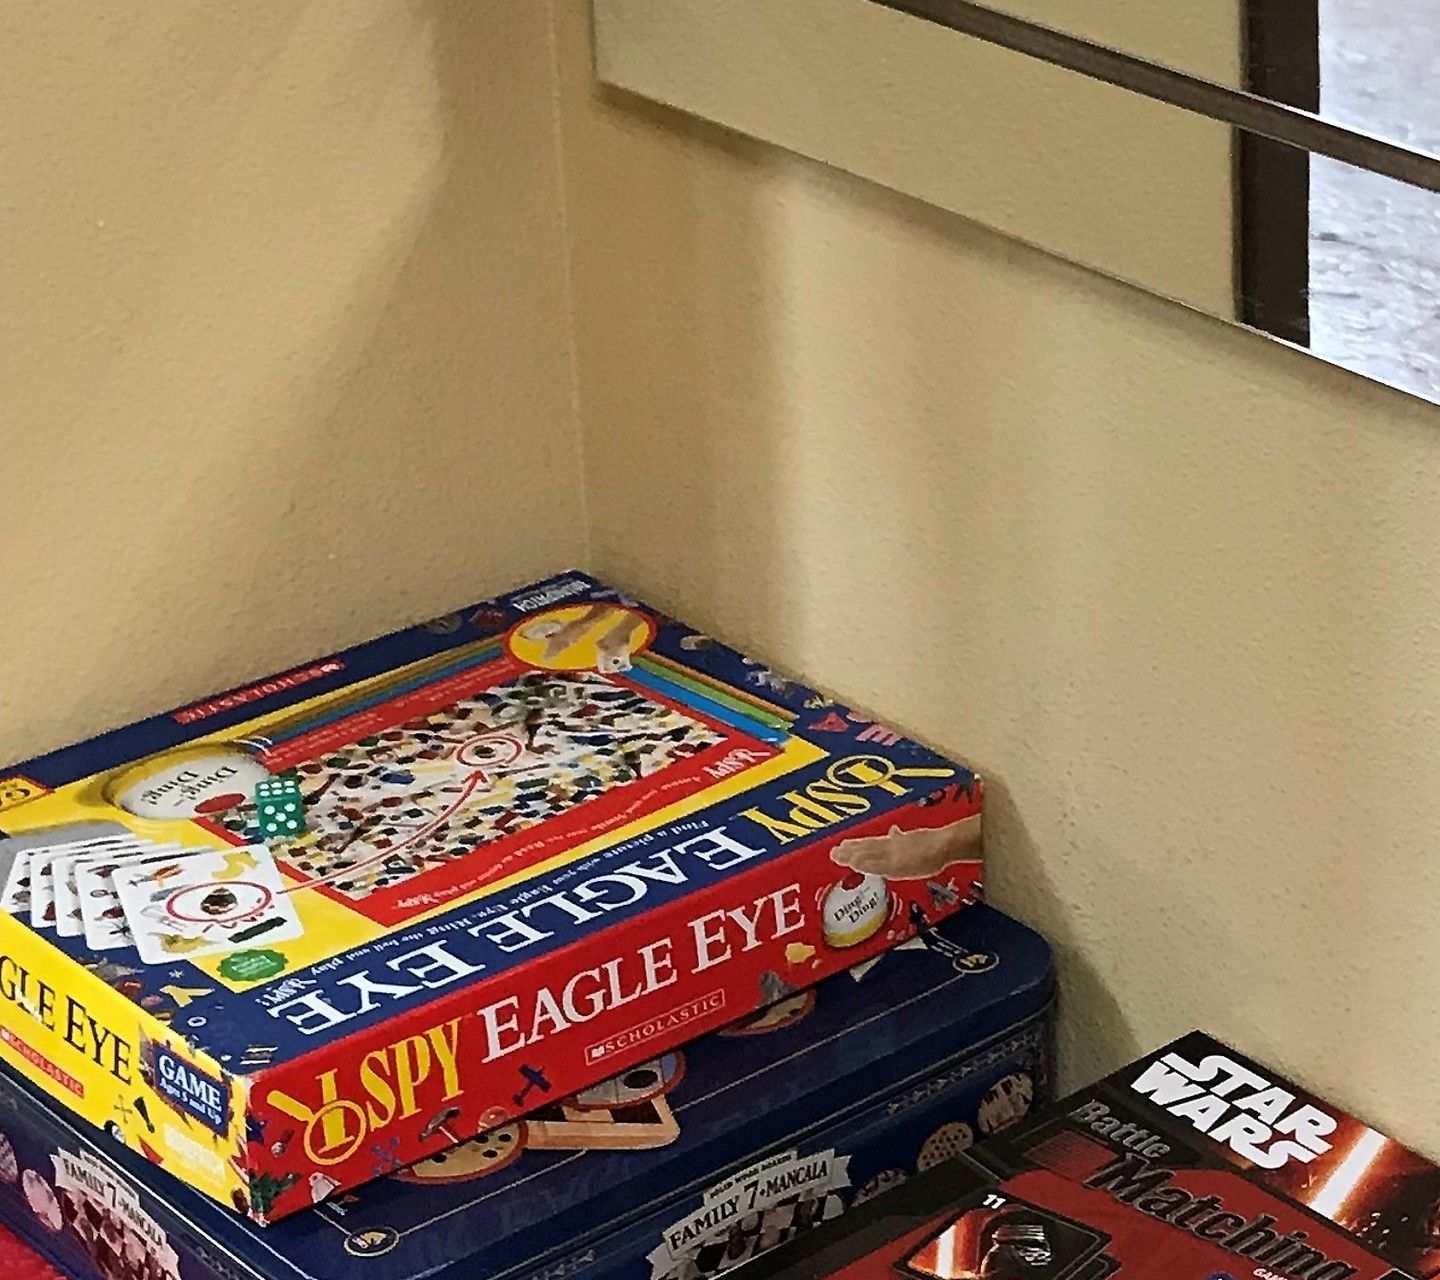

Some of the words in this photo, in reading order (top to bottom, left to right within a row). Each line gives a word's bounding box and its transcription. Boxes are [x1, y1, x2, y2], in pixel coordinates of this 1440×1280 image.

[737, 782, 872, 845] SPY
[468, 824, 767, 953] EAGLE
[509, 885, 553, 907] Eagle
[266, 939, 486, 1035] EYE
[311, 955, 345, 976] play
[360, 1019, 464, 1130] SPY
[477, 937, 677, 1060] EAGLE
[686, 883, 806, 976] EYE
[604, 995, 722, 1055] SCHOLASTIC
[63, 994, 132, 1086] EYE
[158, 1055, 222, 1110] GAME
[1160, 1052, 1339, 1162] STAR
[1078, 1099, 1171, 1160] Battle
[1130, 1061, 1318, 1169] WARS
[669, 1197, 740, 1251] FAMILY
